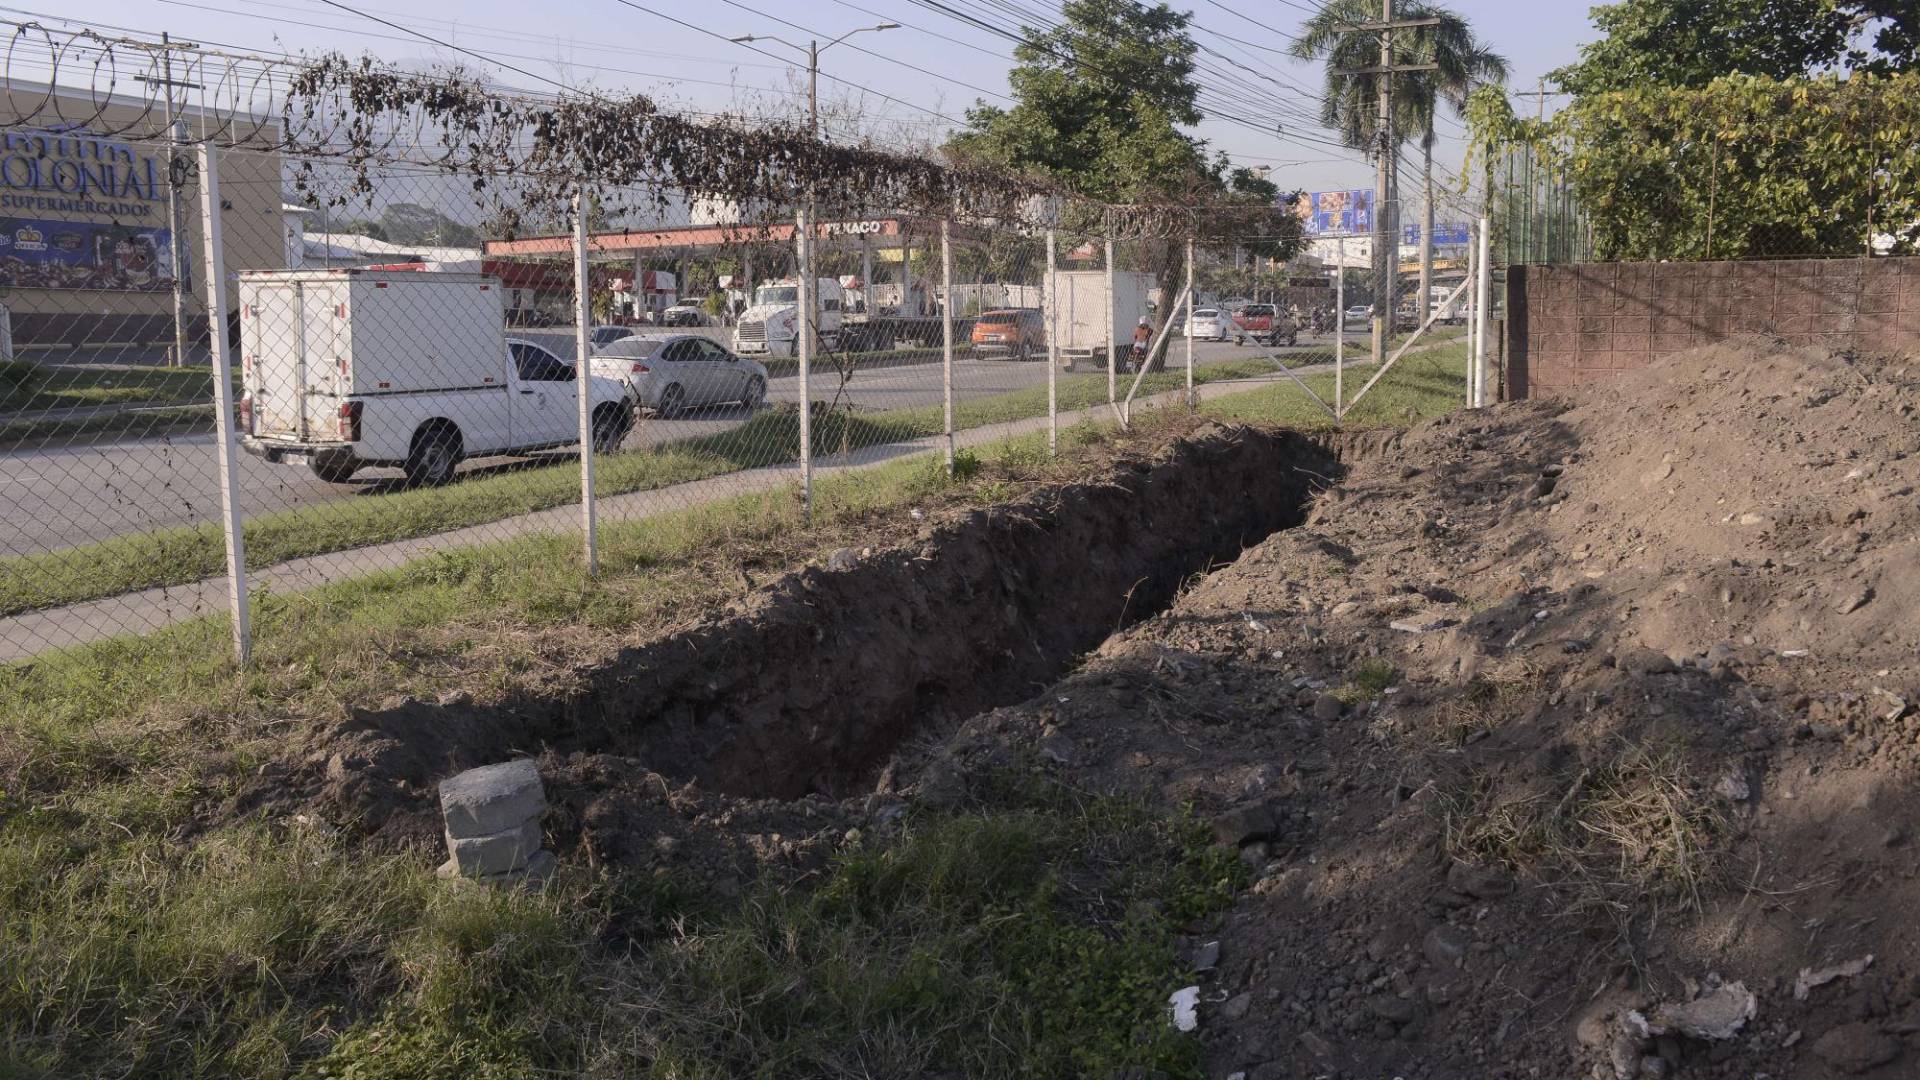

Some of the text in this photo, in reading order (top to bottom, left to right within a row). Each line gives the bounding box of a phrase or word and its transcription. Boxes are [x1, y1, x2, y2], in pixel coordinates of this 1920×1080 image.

[0, 154, 165, 201] OLONIAL
[1, 194, 151, 217] SUPERMERCADOS
[824, 220, 881, 235] TEXACO
